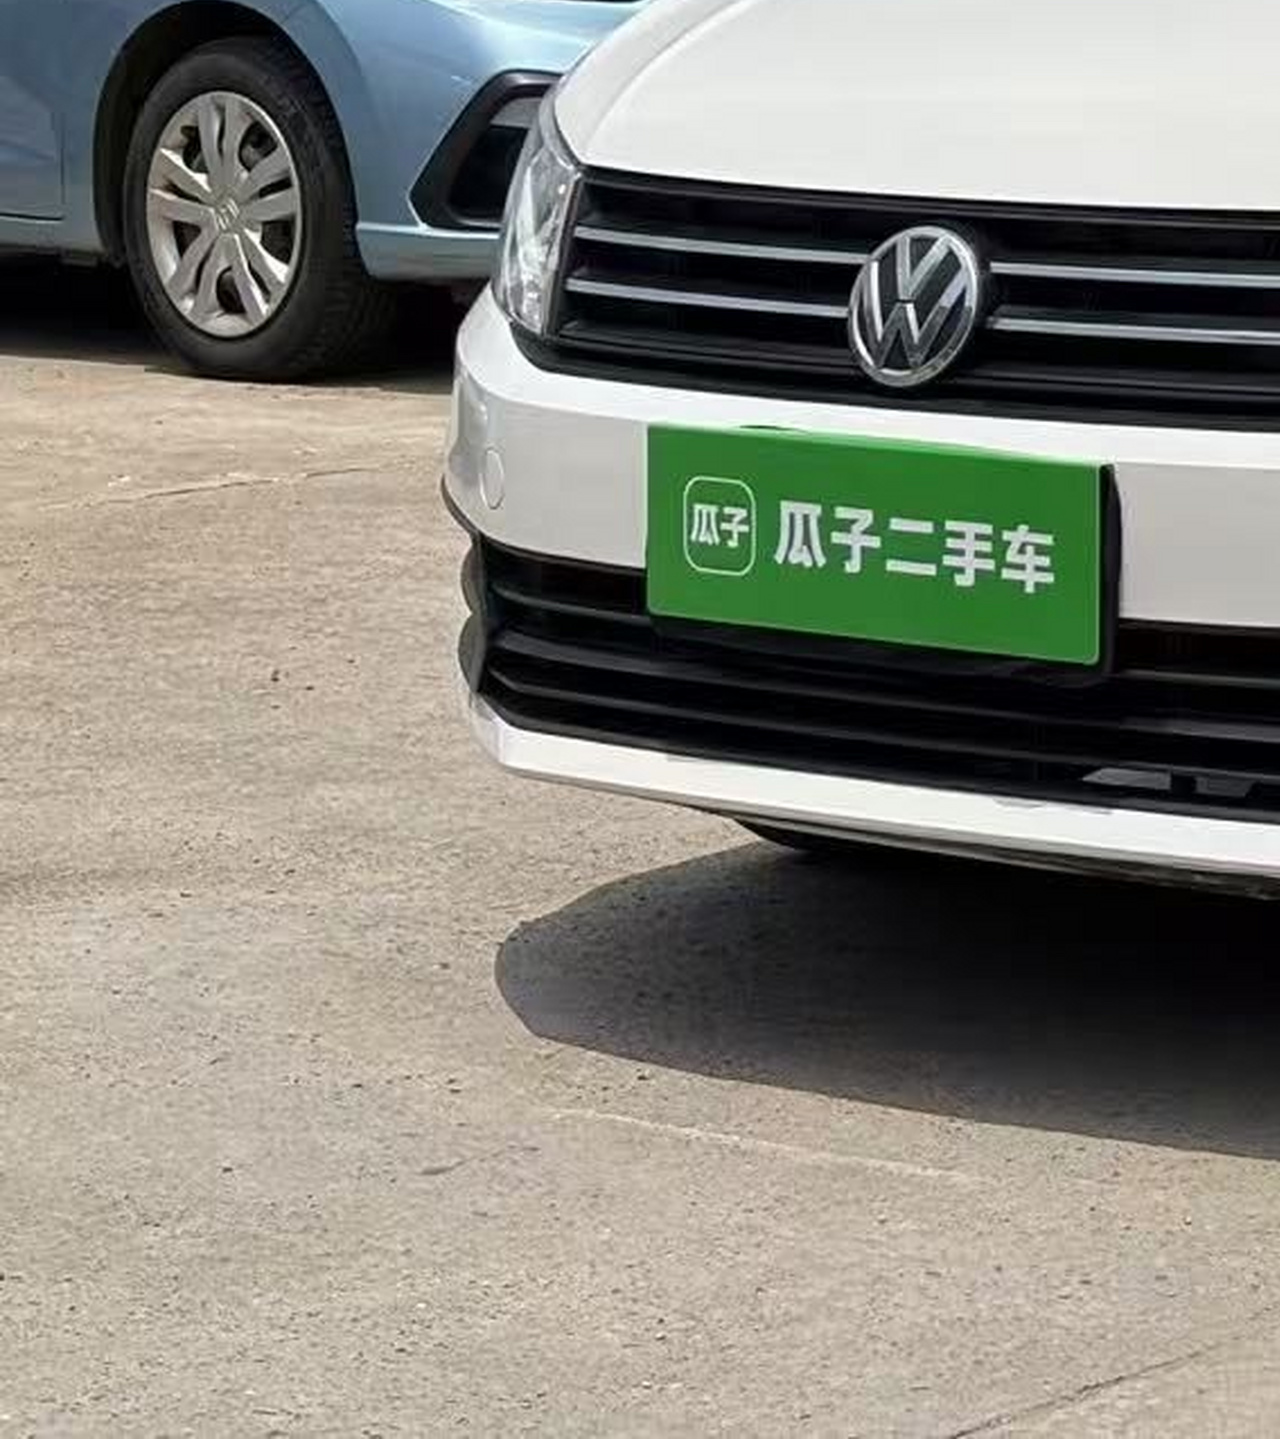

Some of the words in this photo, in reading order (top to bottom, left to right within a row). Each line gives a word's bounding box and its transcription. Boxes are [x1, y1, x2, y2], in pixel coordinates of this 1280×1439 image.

[690, 503, 749, 548] 瓜子
[774, 500, 1055, 594] 瓜子二手车
